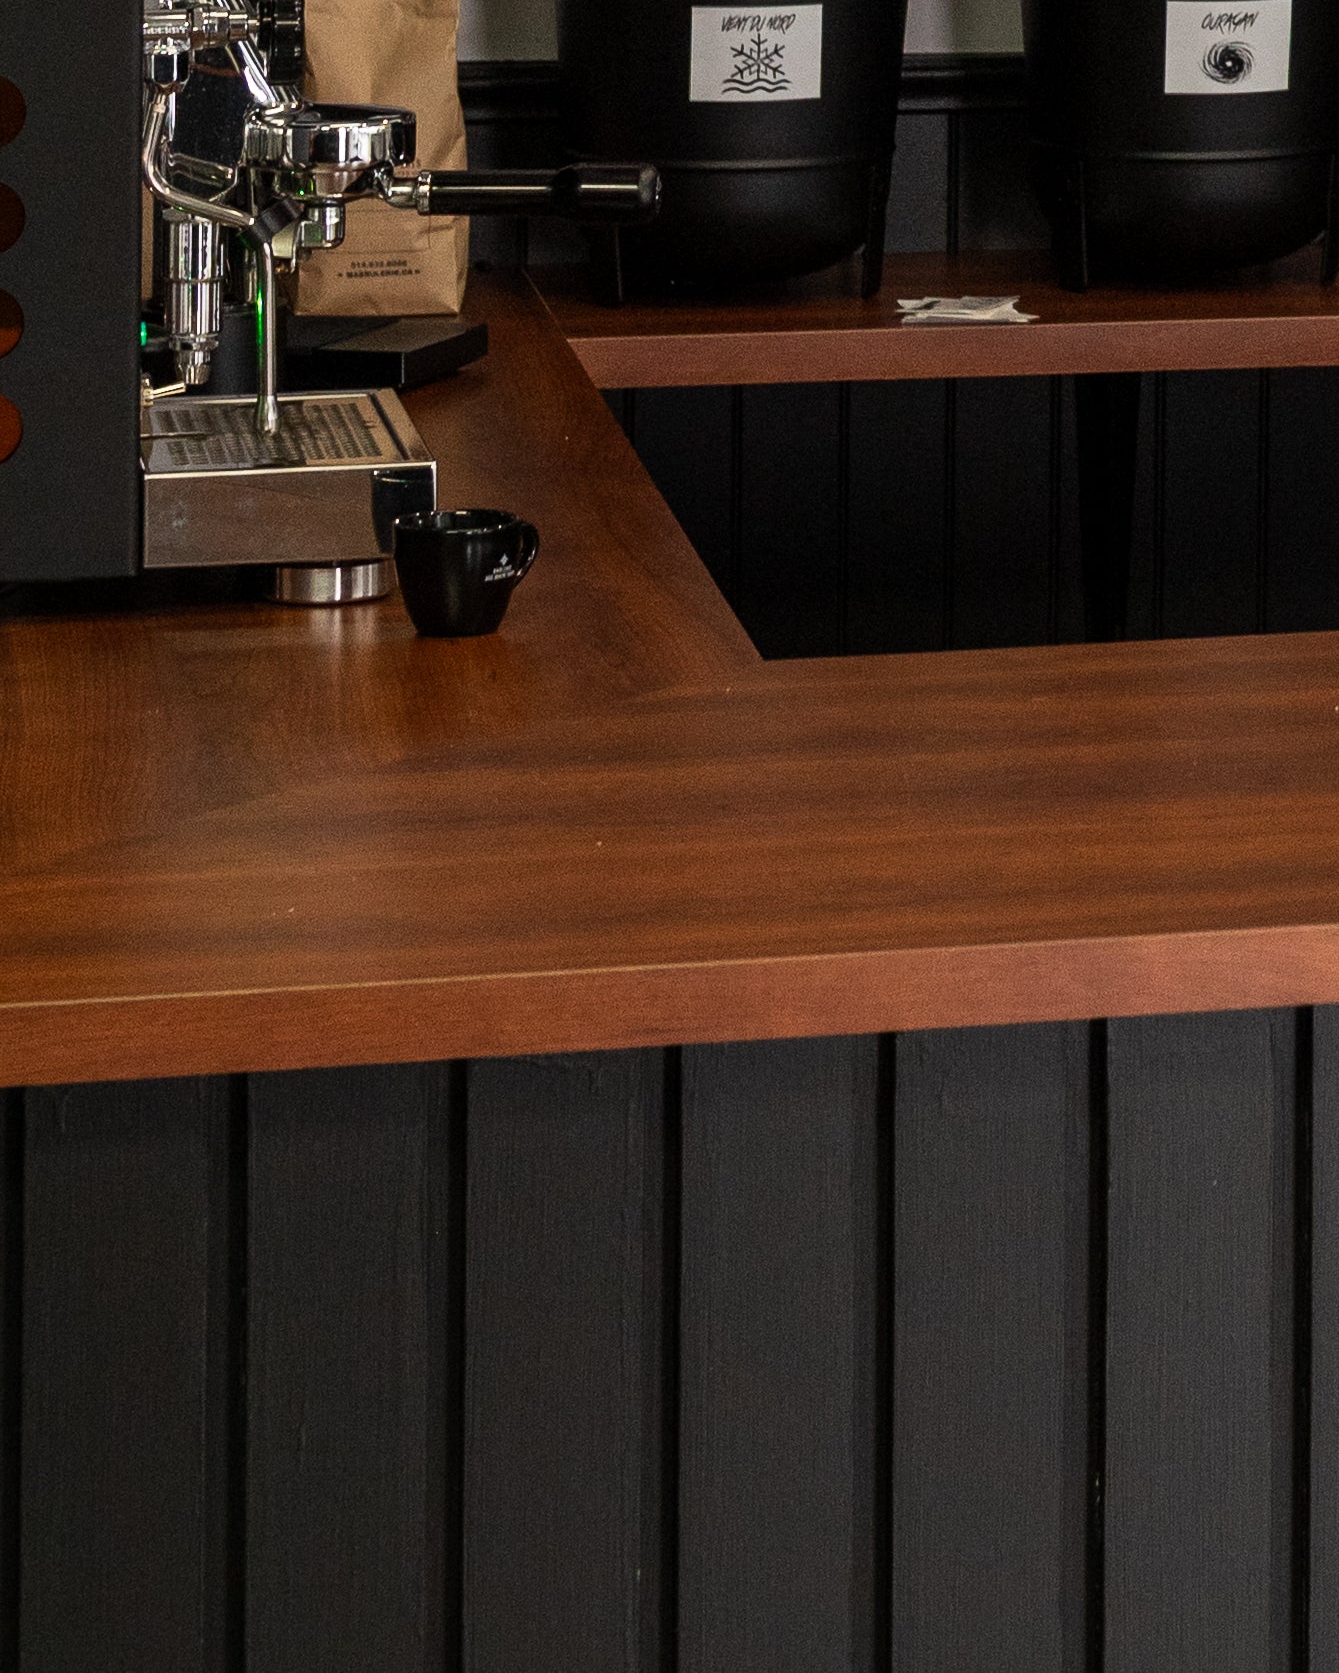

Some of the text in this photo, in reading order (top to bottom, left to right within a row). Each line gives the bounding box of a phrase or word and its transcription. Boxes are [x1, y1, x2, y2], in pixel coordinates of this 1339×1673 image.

[721, 13, 796, 34] VENT DU NORD
[1201, 11, 1259, 34] OURAGAN
